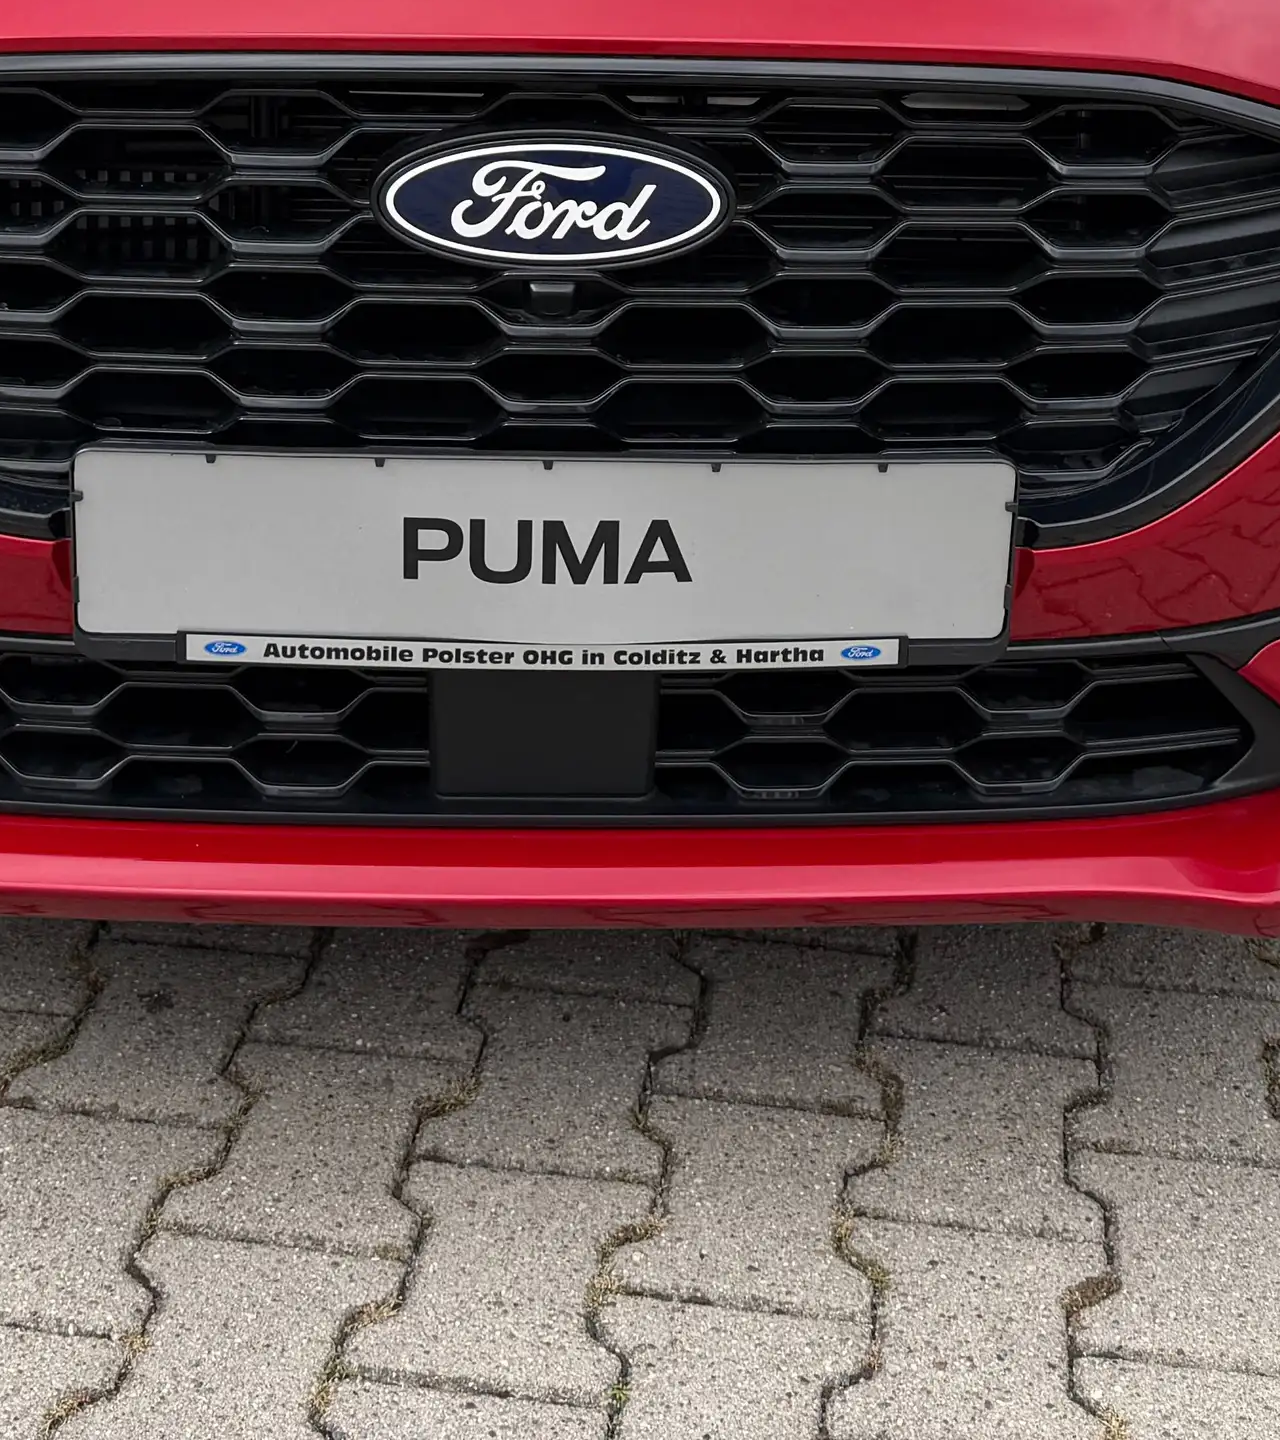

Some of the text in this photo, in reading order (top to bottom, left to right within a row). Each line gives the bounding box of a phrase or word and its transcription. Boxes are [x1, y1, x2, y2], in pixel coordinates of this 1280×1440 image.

[450, 160, 657, 241] Ford
[403, 516, 693, 585] PUMA
[263, 642, 825, 666] Automobile Polster OHG in Colditz & Hartha
